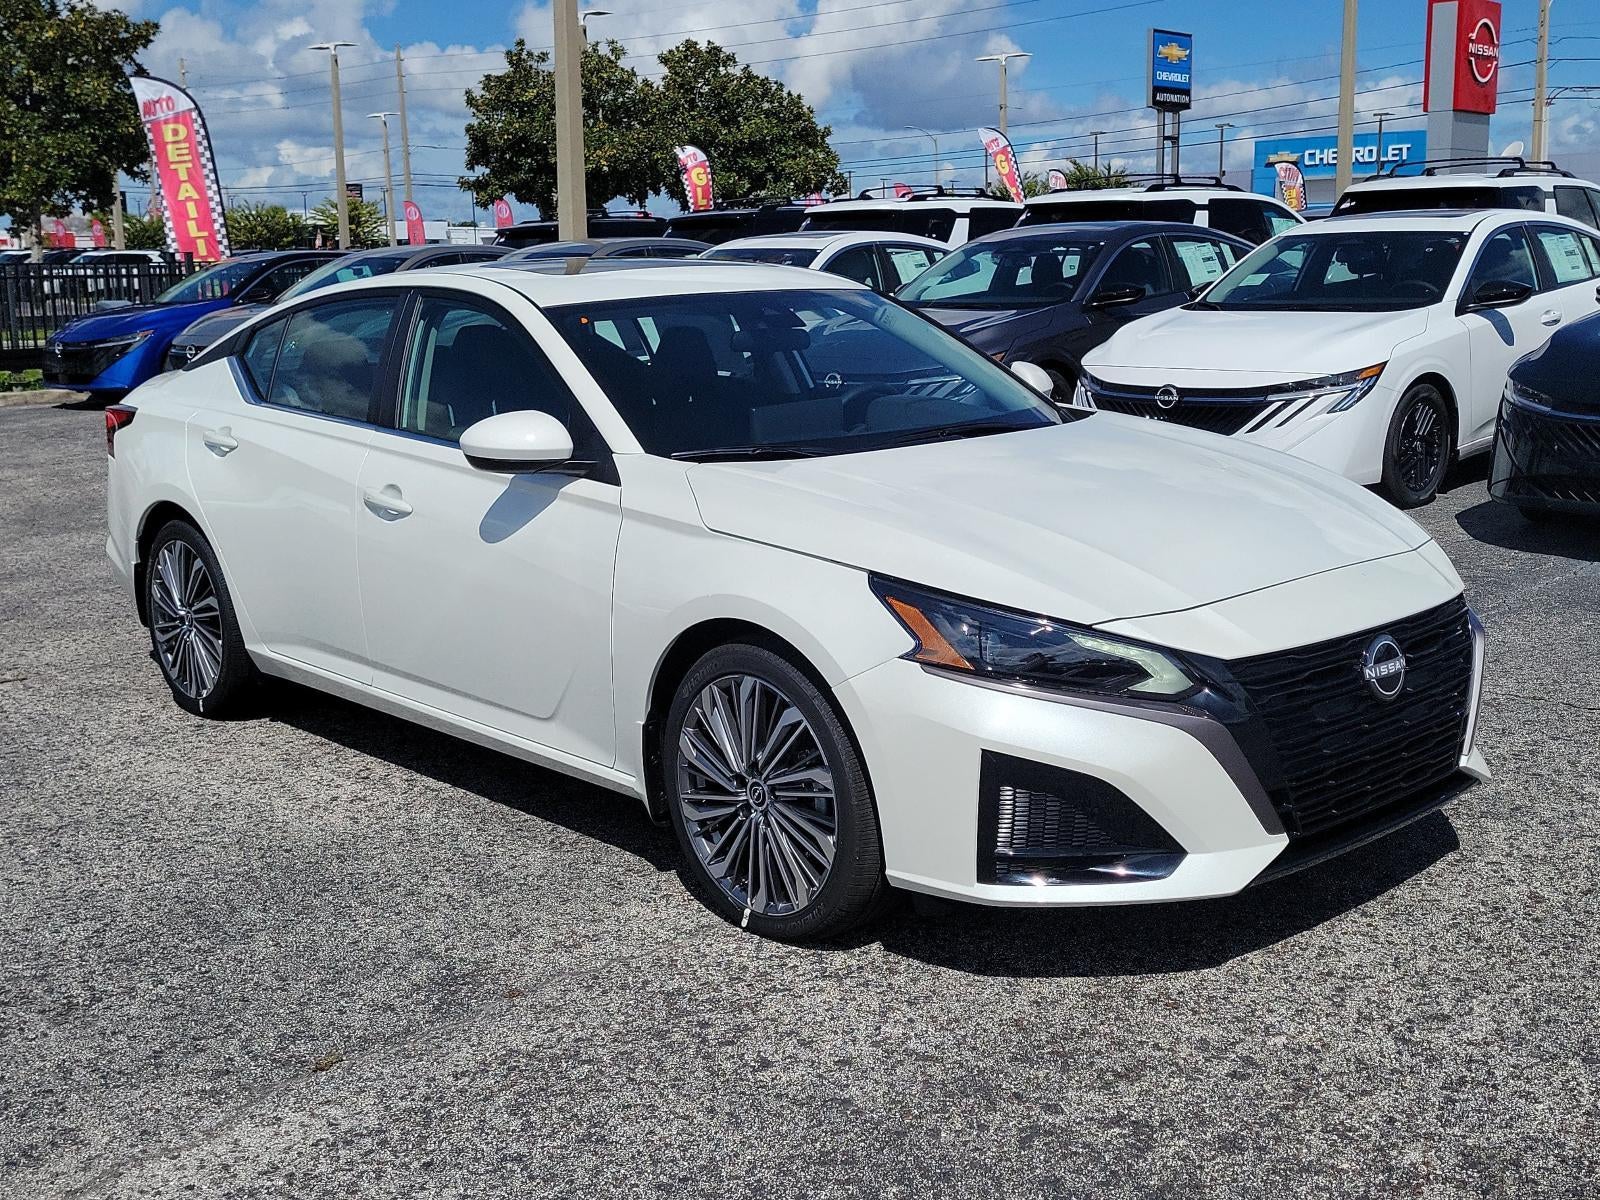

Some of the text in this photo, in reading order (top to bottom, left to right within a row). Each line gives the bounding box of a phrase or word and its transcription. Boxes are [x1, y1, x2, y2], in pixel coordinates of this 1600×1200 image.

[1468, 43, 1499, 57] NISSAN
[1156, 71, 1190, 83] CHEVROLET
[142, 95, 175, 118] AUTO
[1156, 92, 1190, 104] AUTONATION
[1303, 144, 1412, 166] CHEROLET
[161, 123, 215, 261] DETAILI
[1364, 655, 1407, 679] NISSAN
